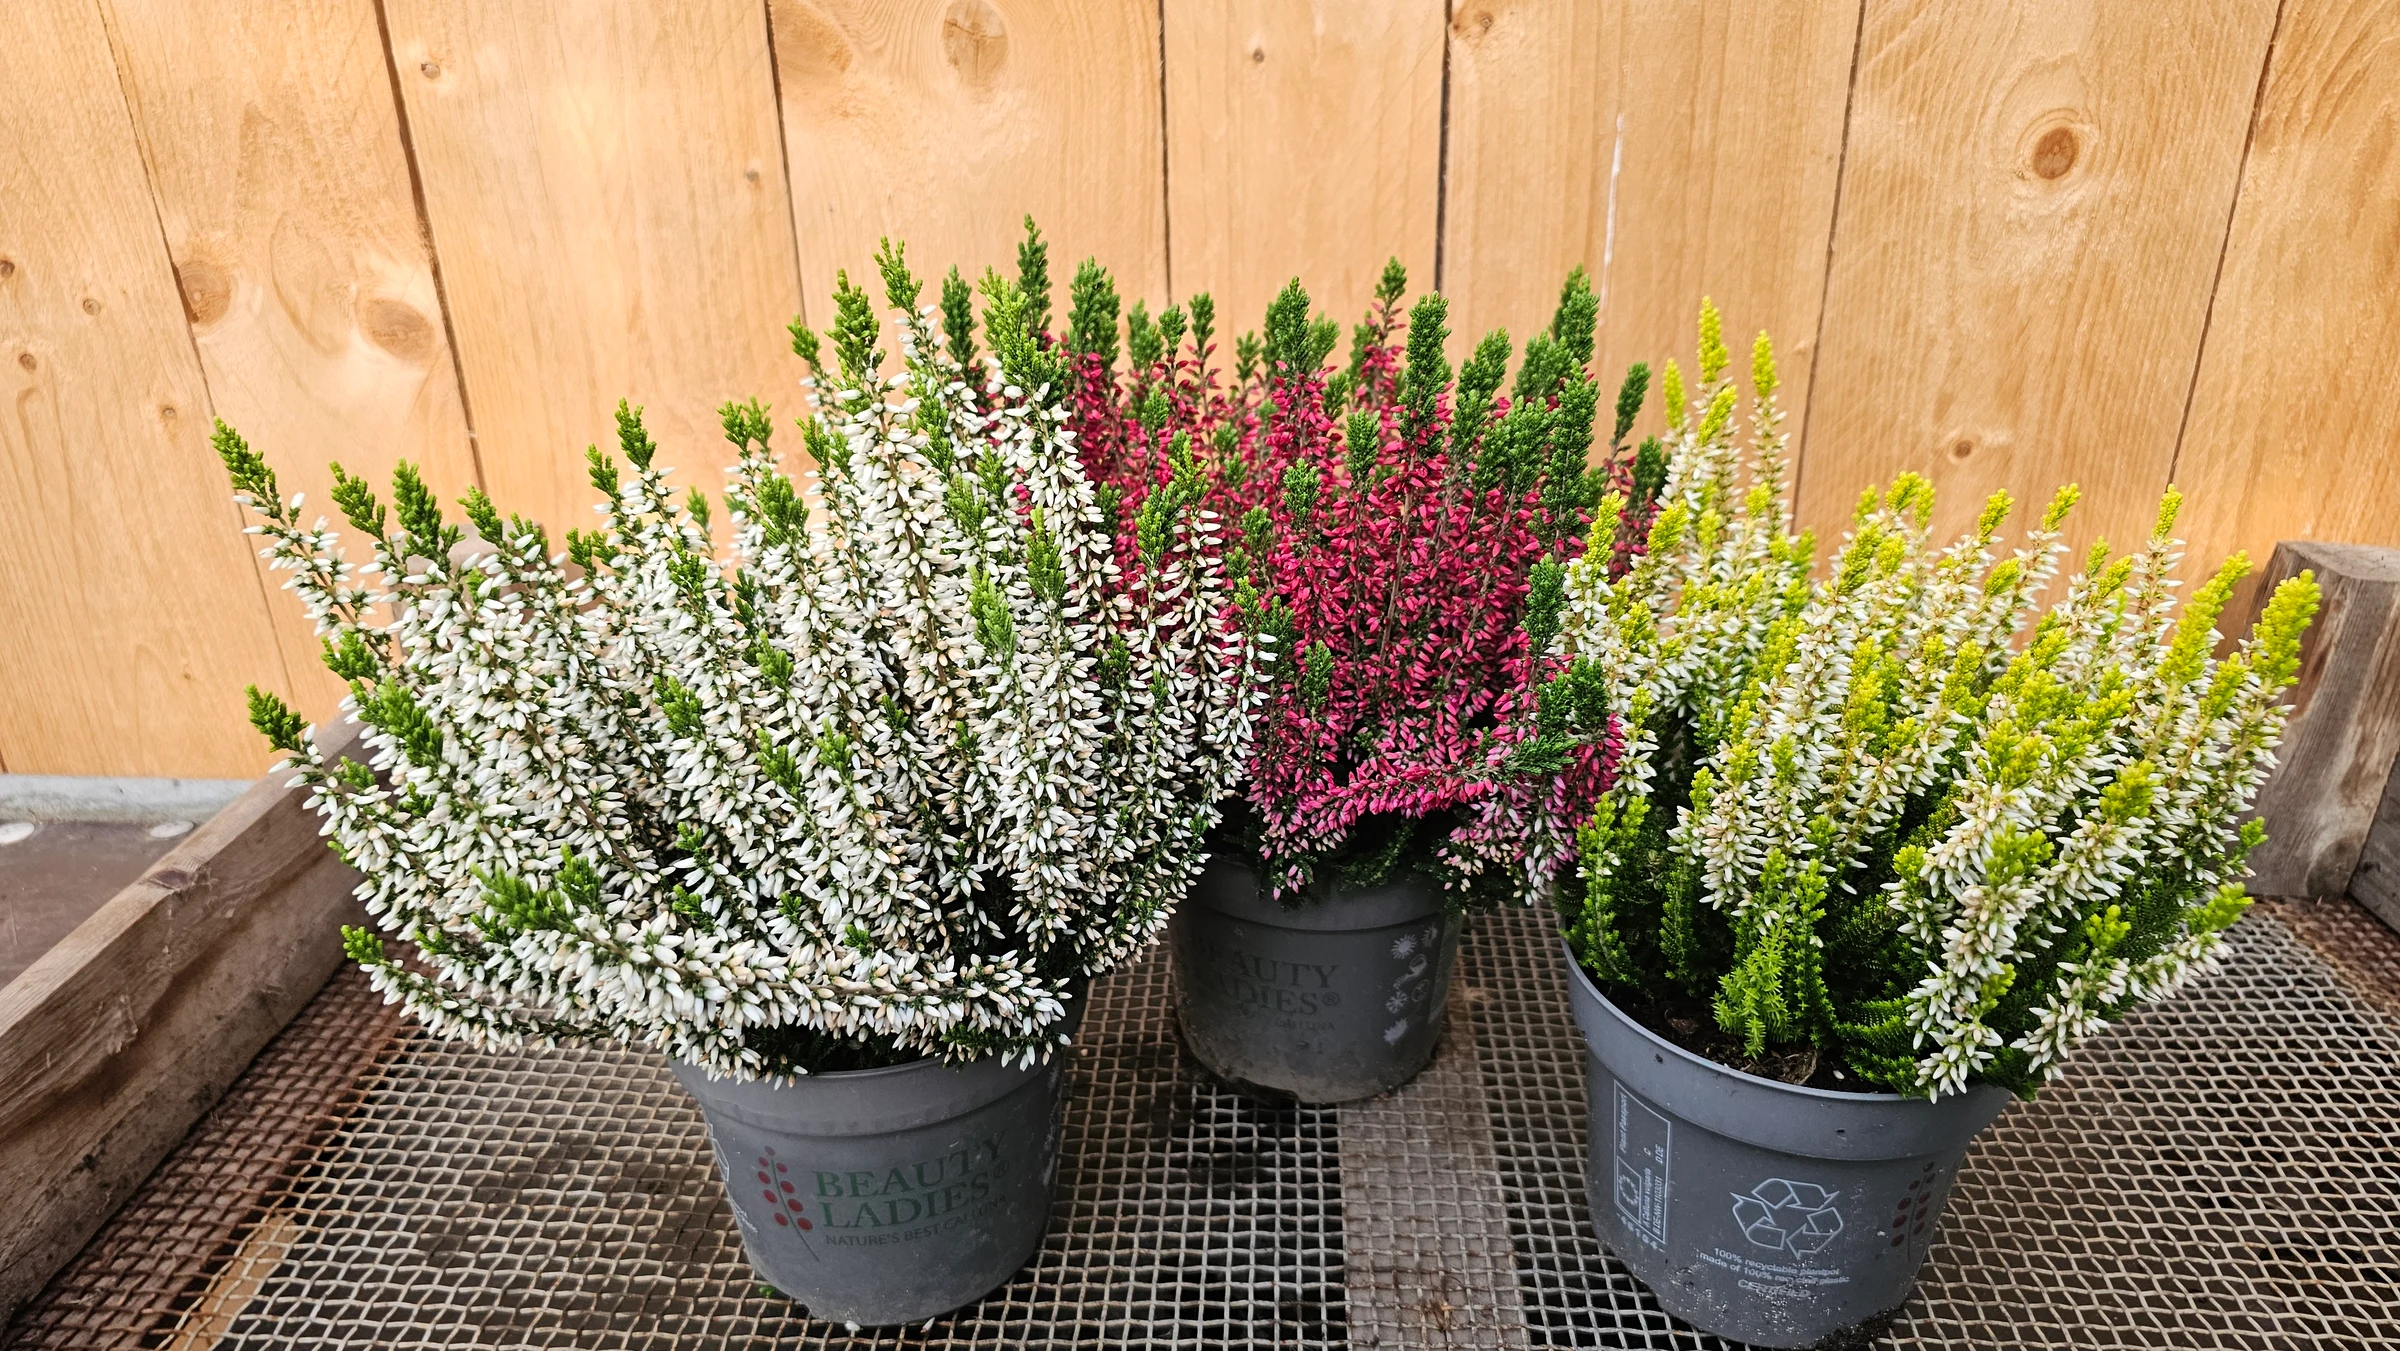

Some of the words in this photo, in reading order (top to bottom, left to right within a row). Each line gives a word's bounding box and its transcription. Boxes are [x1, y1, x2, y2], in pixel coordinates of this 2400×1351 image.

[811, 1128, 1008, 1198] BEAUTY
[825, 1231, 901, 1247] NATURE'S
[903, 1224, 939, 1242] BEST
[1699, 1252, 1728, 1269] made
[1729, 1263, 1741, 1273] of
[1743, 1266, 1773, 1281] 100%
[1818, 1275, 1851, 1286] plastic
[1714, 1247, 1743, 1264] 100%
[1744, 1258, 1798, 1275] recyclable
[1799, 1267, 1840, 1277] plantpot
